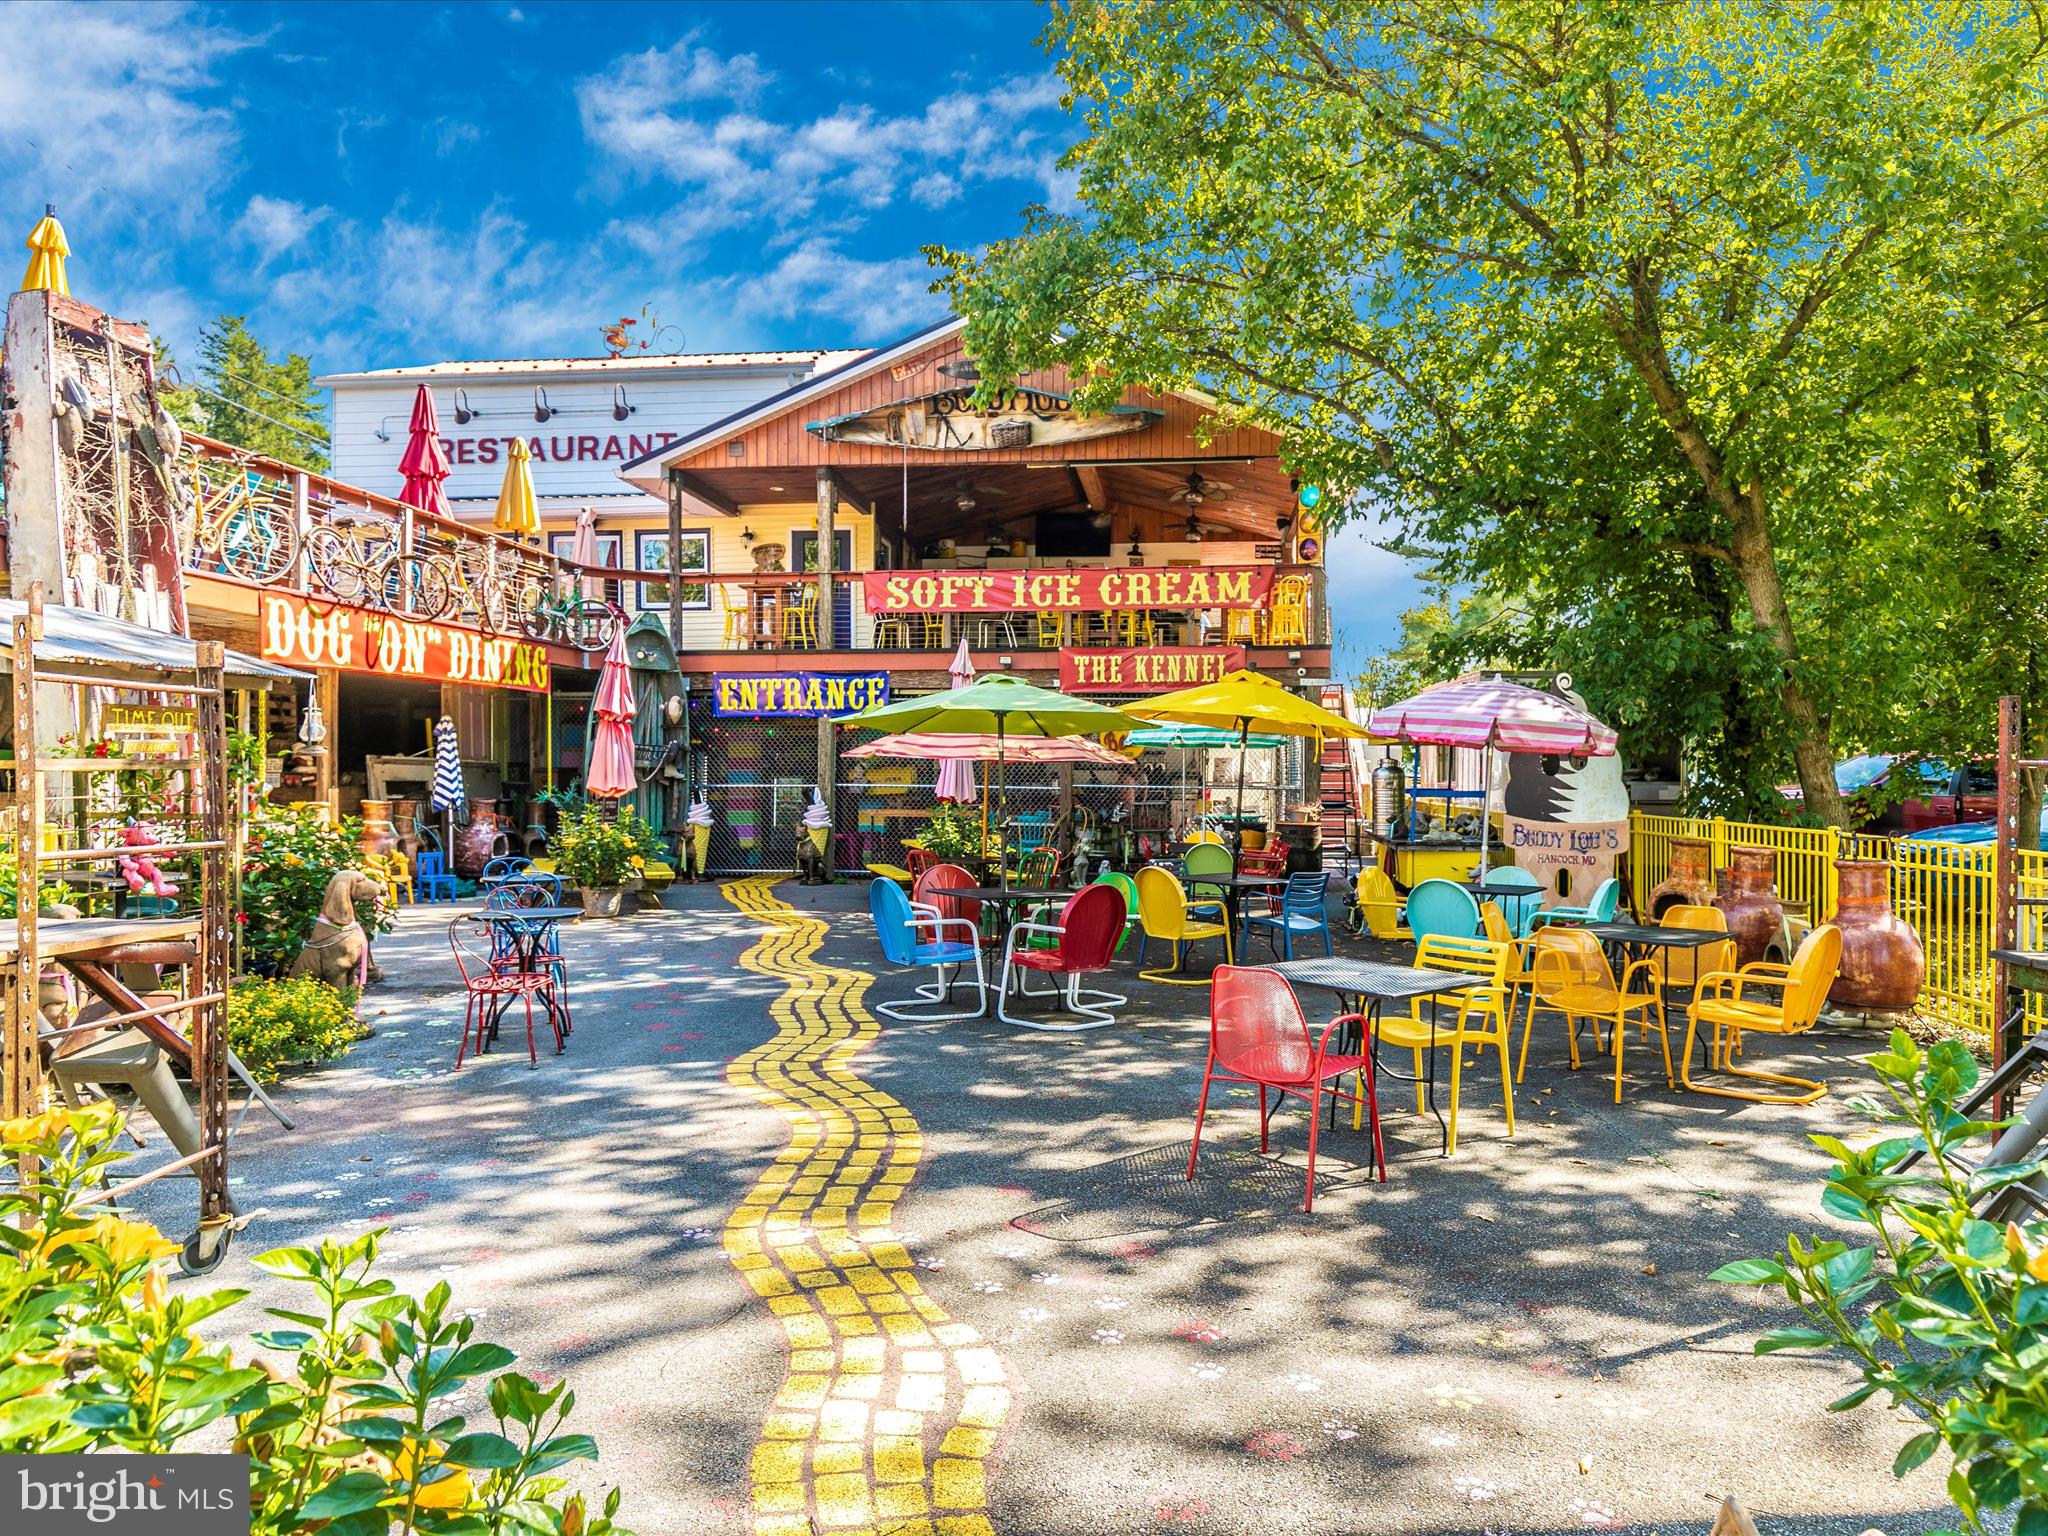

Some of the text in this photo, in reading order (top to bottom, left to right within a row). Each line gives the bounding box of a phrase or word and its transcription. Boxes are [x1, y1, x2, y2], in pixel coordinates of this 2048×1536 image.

[437, 432, 678, 464] RESTAURANT
[886, 571, 1254, 609] SOFT ICE CREAM
[264, 596, 353, 666] DOG
[447, 630, 548, 689] DINING
[1074, 654, 1230, 684] THE KENNEL
[719, 678, 885, 711] ENTRANCE
[111, 708, 194, 731] TIME OUT
[1511, 823, 1619, 854] BUDDY LOU'S
[1582, 855, 1597, 866] MD
